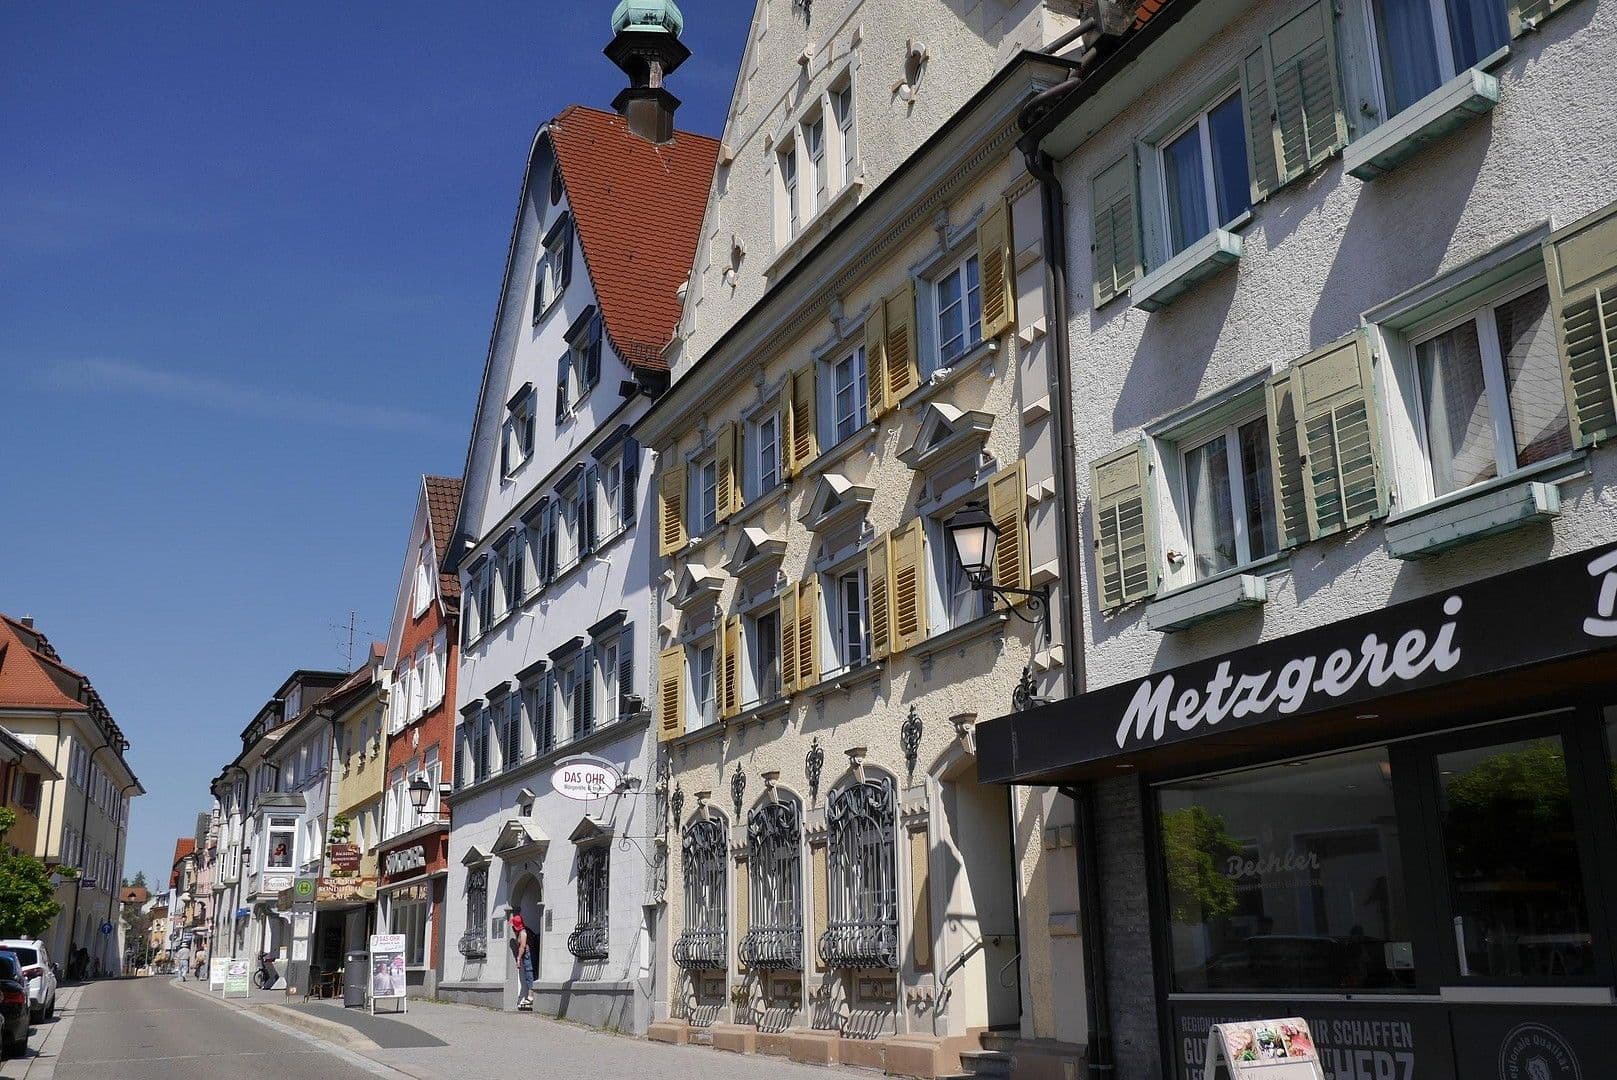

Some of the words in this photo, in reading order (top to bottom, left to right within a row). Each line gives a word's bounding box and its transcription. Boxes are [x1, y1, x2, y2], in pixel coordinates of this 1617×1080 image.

[1116, 596, 1462, 749] Metzgerei
[564, 771, 581, 783] DAS
[585, 772, 605, 785] OHR
[1332, 1018, 1414, 1048] SCHAFFEN
